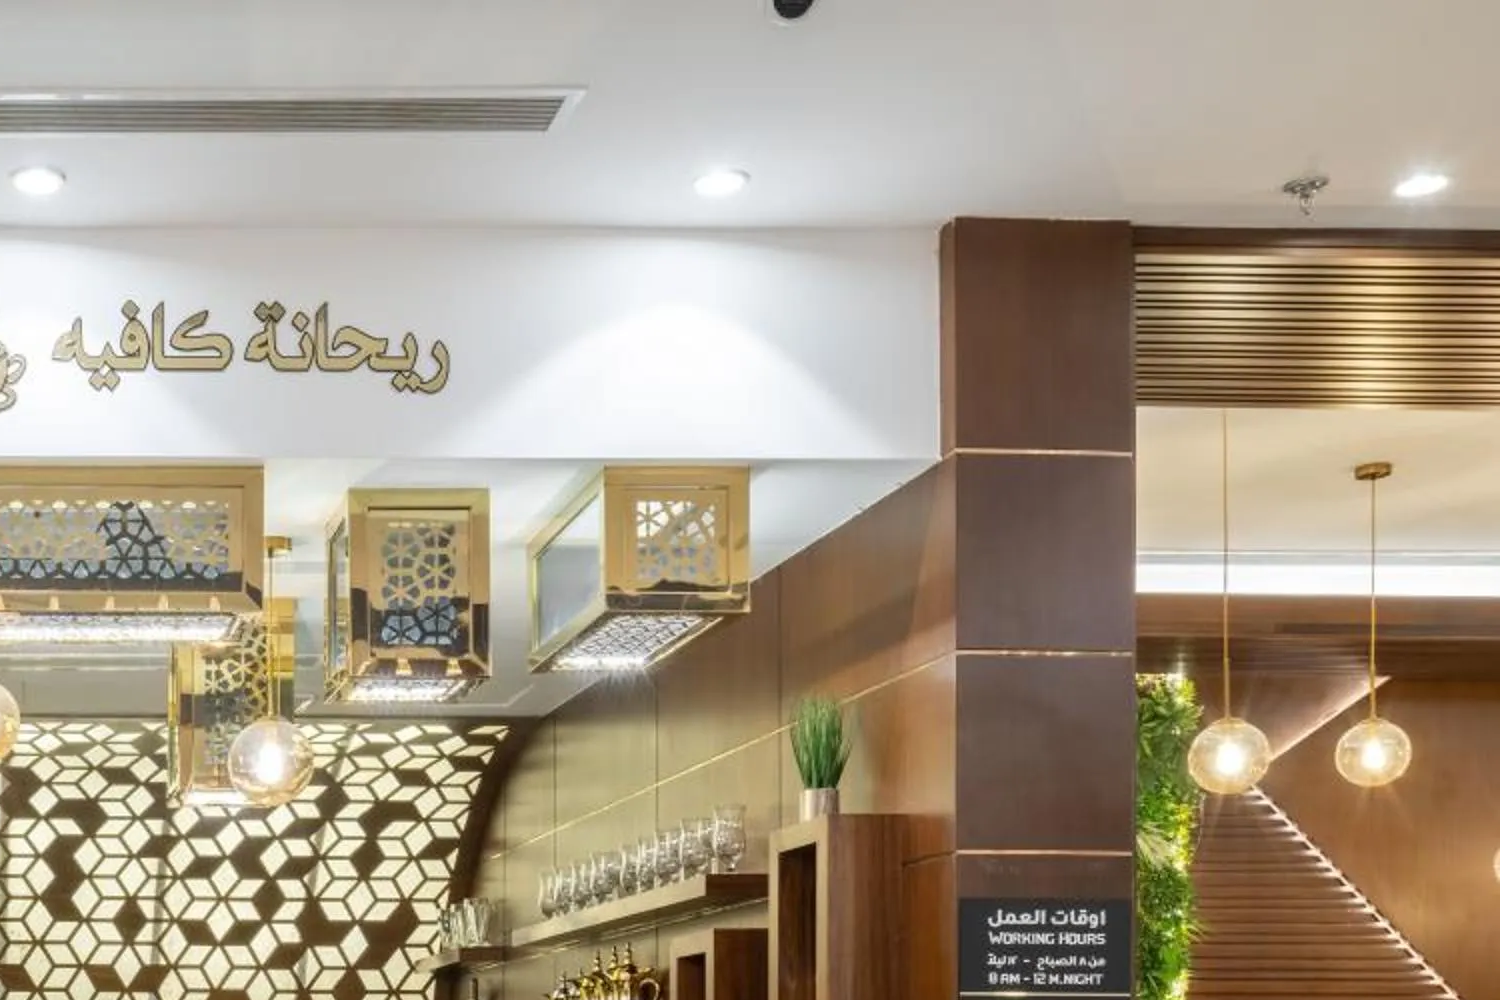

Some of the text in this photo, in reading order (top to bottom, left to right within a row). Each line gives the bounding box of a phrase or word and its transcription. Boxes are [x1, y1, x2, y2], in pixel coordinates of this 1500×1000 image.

[51, 298, 451, 395] ريحانة كافيه
[987, 908, 1106, 929] اوقات العمل
[988, 931, 1106, 945] WORKING HOURS
[1036, 955, 1077, 971] الصباح
[1000, 972, 1021, 985] AM
[1033, 972, 1047, 985] 12
